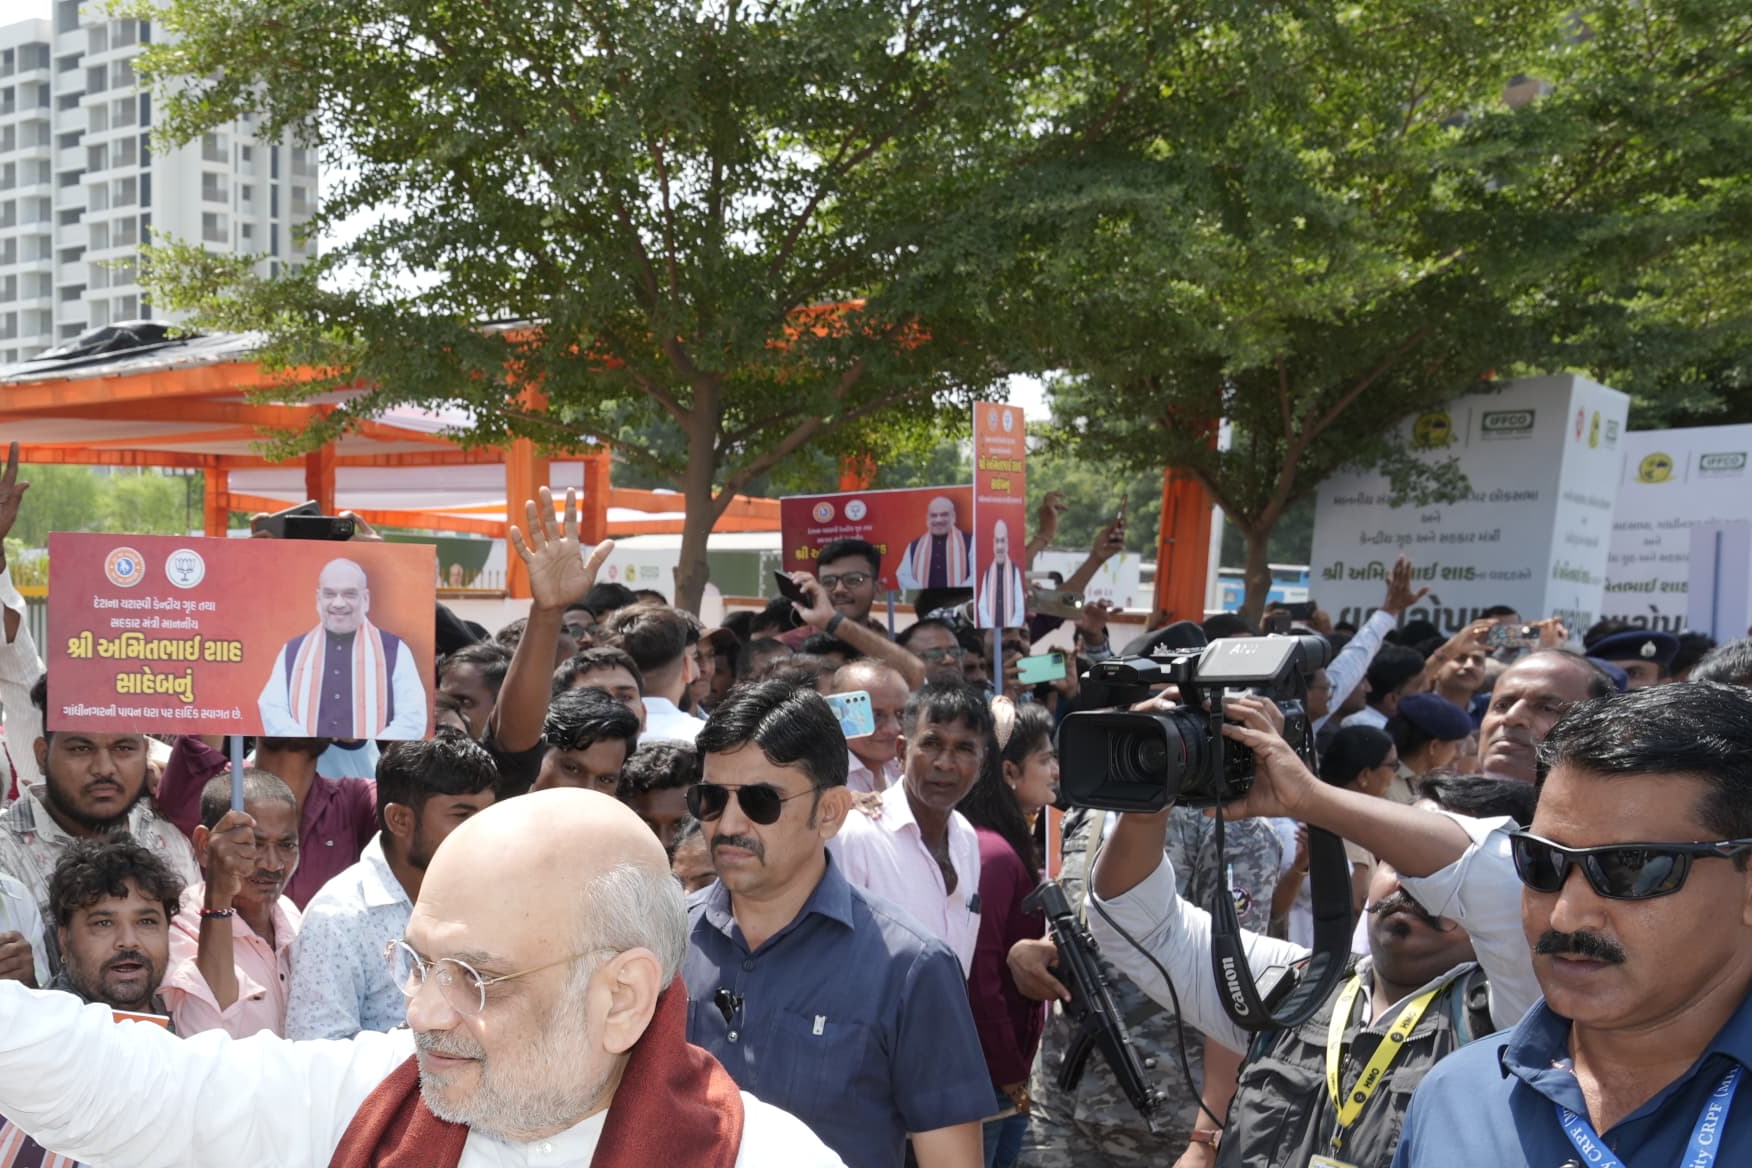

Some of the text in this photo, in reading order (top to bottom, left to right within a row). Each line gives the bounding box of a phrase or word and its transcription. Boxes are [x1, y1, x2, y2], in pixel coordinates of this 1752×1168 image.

[1321, 561, 1344, 581] શ્રી
[93, 595, 119, 609] દેશના
[120, 597, 152, 611] યશસ્વી
[182, 600, 197, 613] ગૃહ
[198, 600, 216, 612] તથા
[110, 616, 199, 630] સહકાર મંત્રી માનનીય
[66, 630, 243, 662] શ્રી અમિતભાઈ શાહ
[115, 666, 195, 703] સાહેબનું
[63, 704, 116, 718] ગાંધીનગરની
[118, 707, 142, 719] પાવન
[143, 706, 159, 718] ધરા
[161, 706, 174, 719] પર
[200, 707, 230, 720] સ્વાગત
[1222, 957, 1250, 1017] Canon
[1363, 1067, 1380, 1089] HMO
[1698, 1103, 1722, 1146] CRPF
[1570, 1127, 1602, 1163] CRPF
